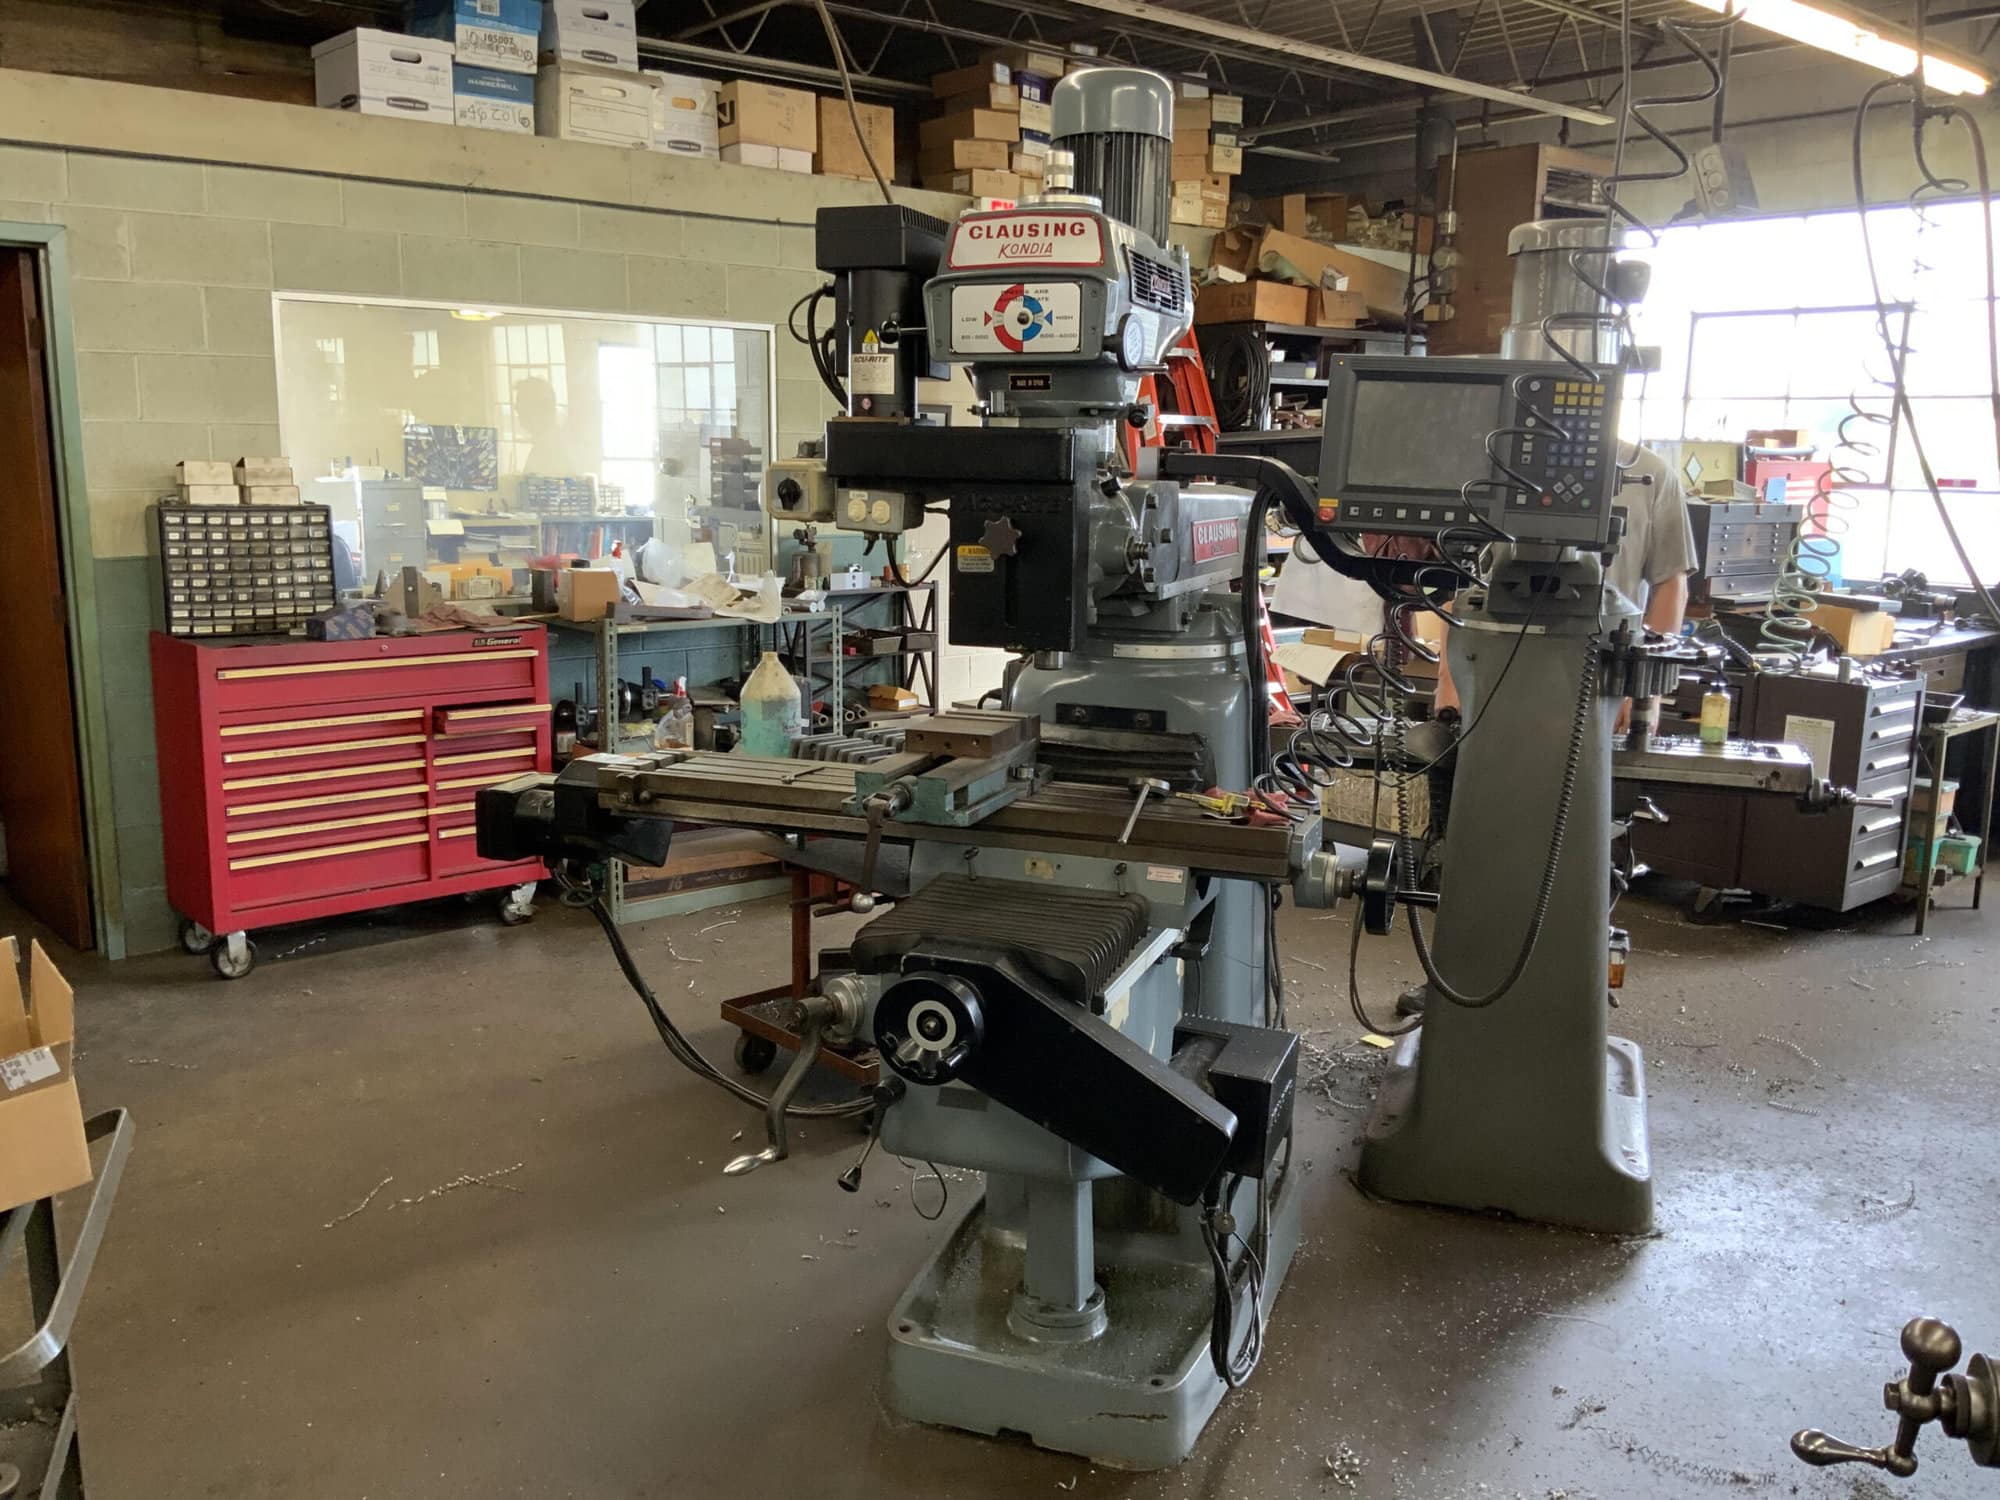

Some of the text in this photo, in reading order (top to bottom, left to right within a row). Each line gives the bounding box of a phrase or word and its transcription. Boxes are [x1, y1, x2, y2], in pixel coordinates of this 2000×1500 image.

[968, 221, 1086, 240] CLAUSING
[998, 242, 1054, 259] KONDIA
[1198, 522, 1238, 545] CLAUSING
[487, 637, 522, 646] General
